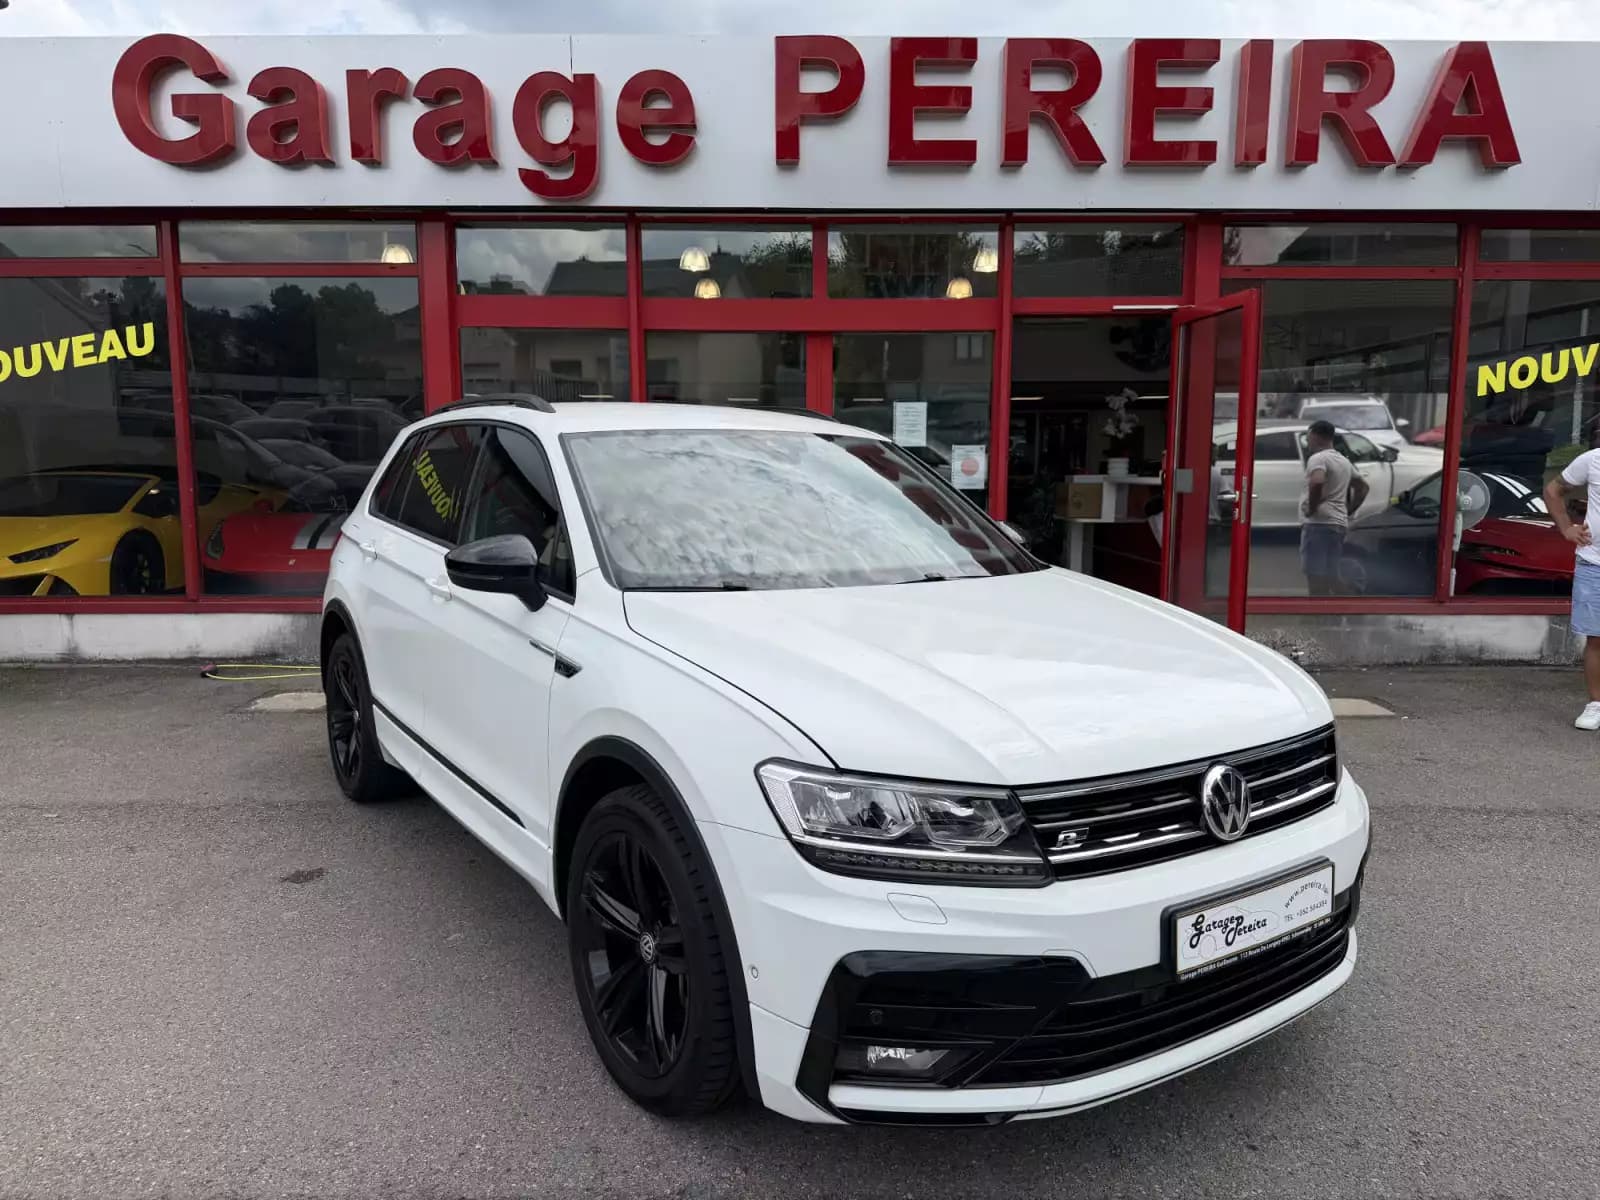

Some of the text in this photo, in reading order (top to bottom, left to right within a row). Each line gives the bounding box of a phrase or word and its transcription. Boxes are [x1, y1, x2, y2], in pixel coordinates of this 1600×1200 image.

[111, 33, 1522, 201] Garage PEREIRA
[1189, 913, 1235, 949] Garage
[1225, 915, 1268, 947] Pereira
